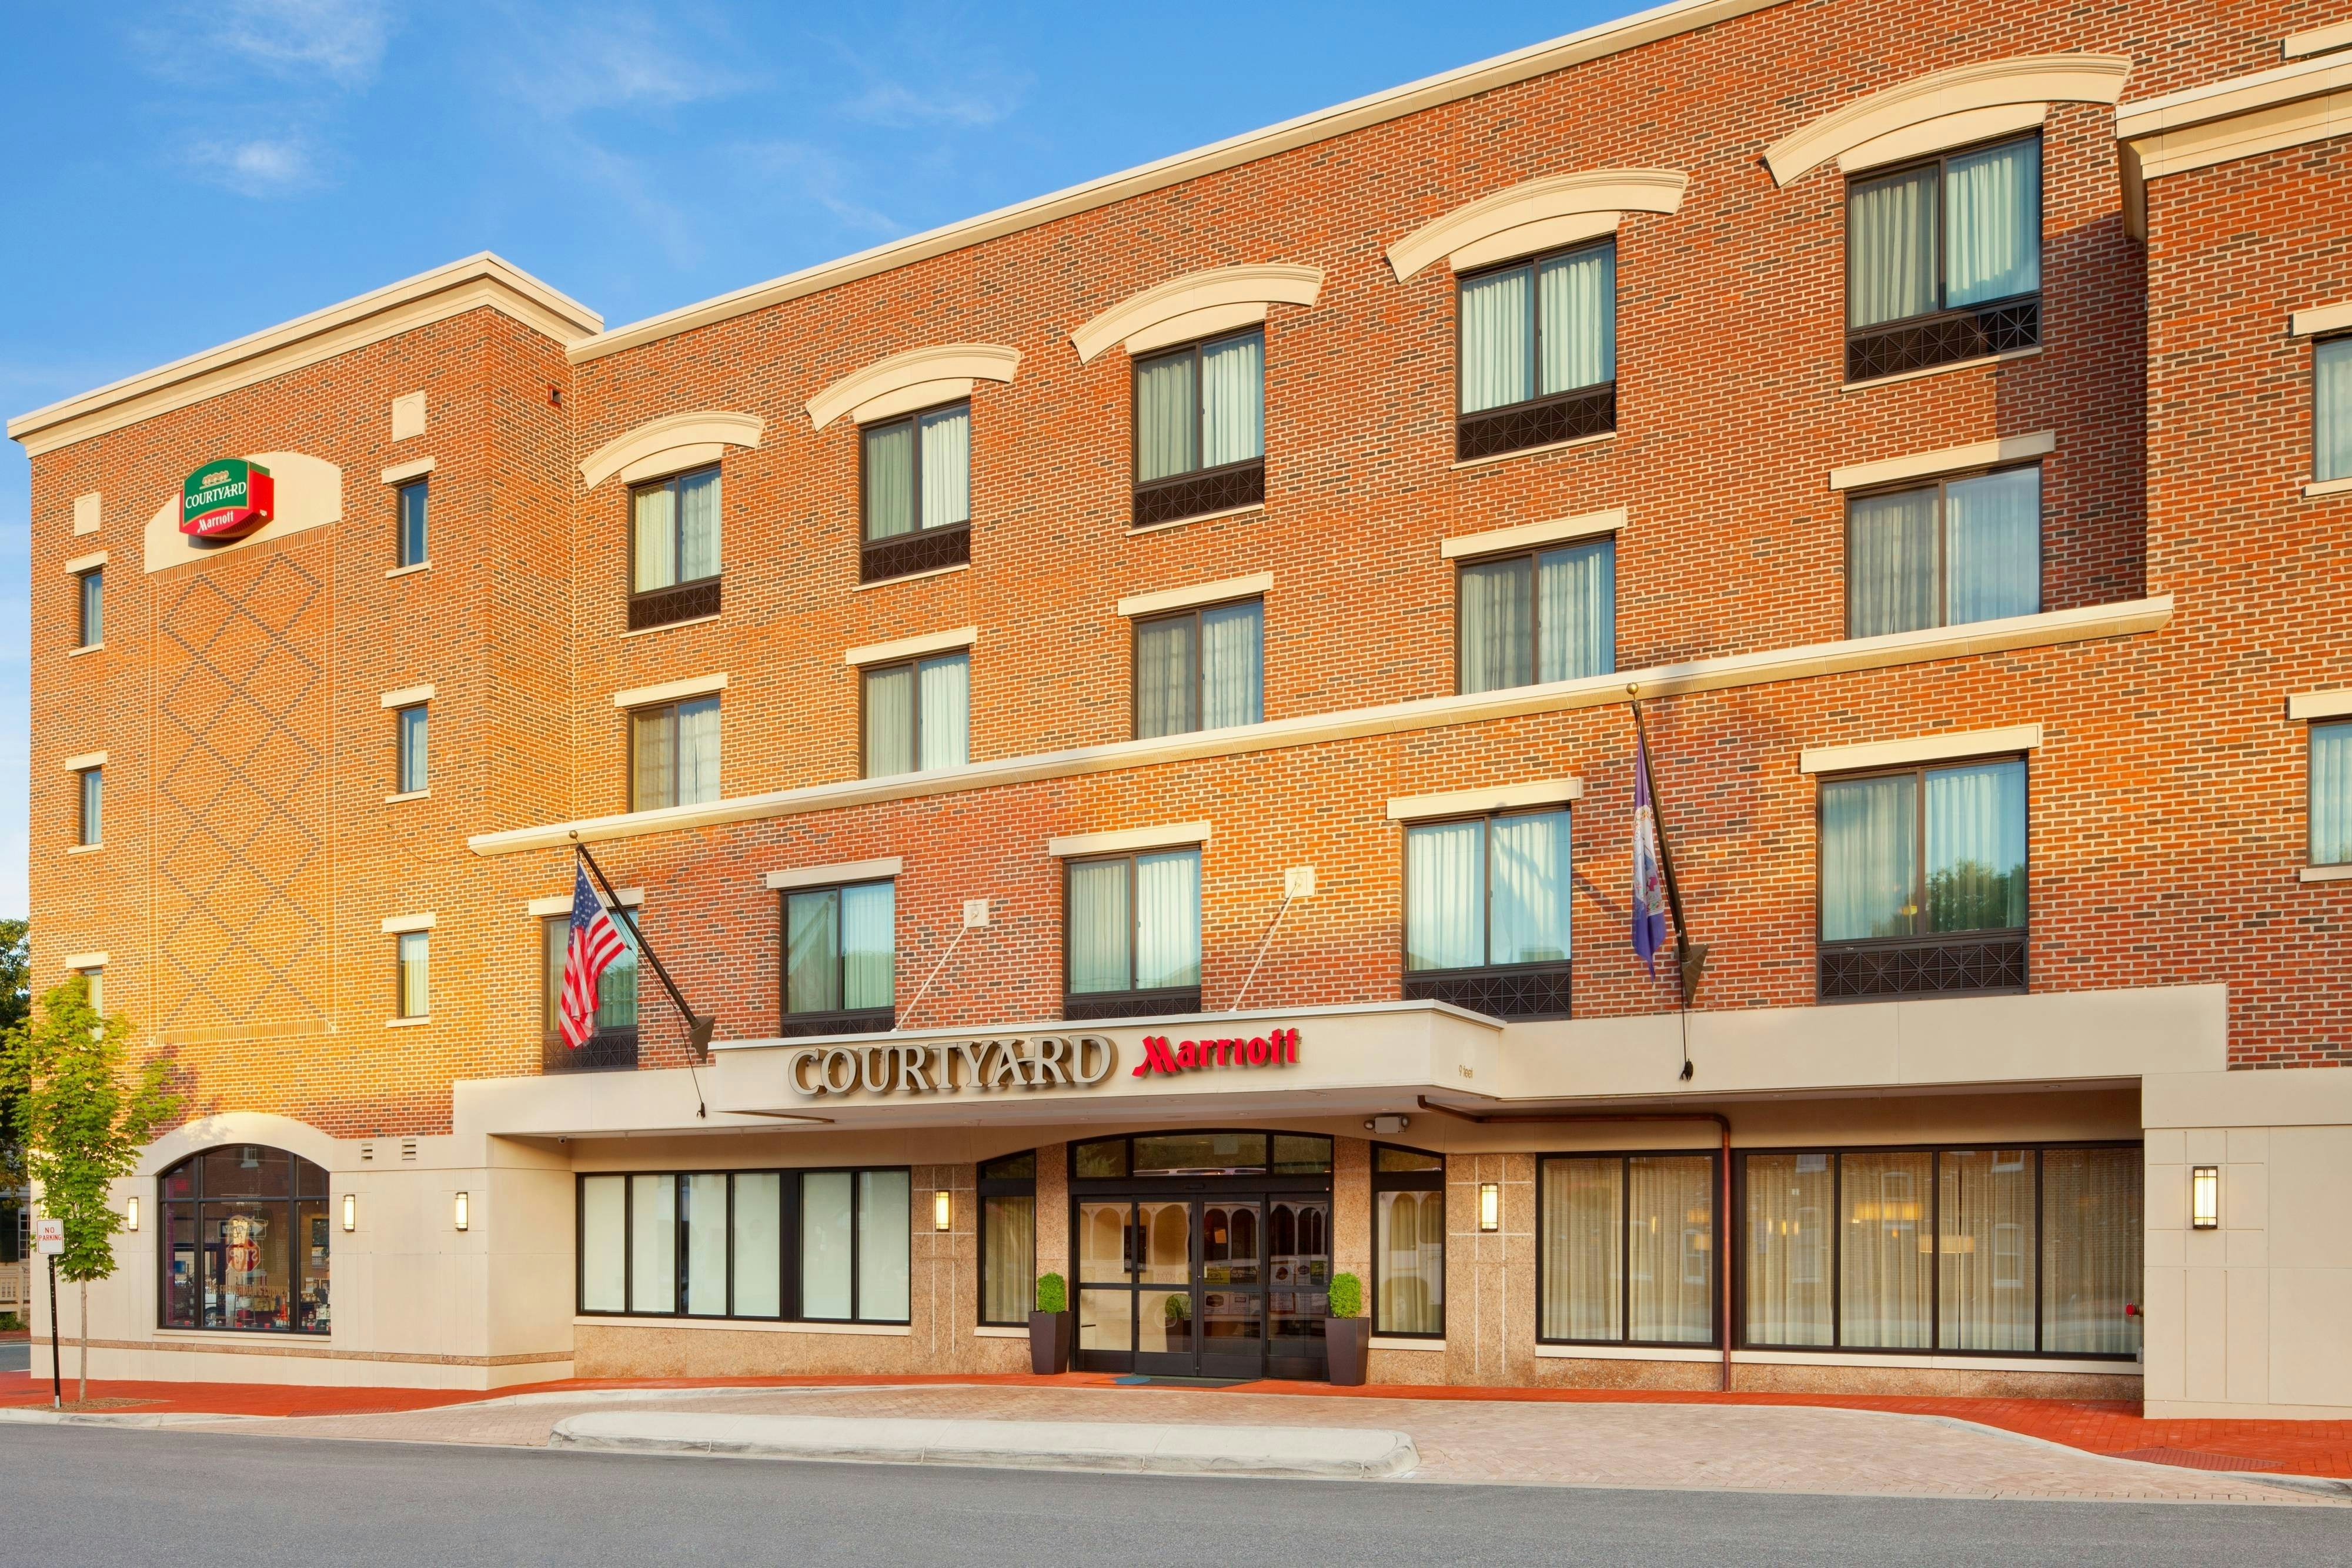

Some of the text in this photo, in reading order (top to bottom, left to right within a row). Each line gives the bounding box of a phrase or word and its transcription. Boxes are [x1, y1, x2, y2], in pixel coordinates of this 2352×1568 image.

[185, 482, 246, 509] COURTYARD
[197, 510, 234, 533] Marriott
[788, 1028, 1302, 1095] COURTYARD Marriott
